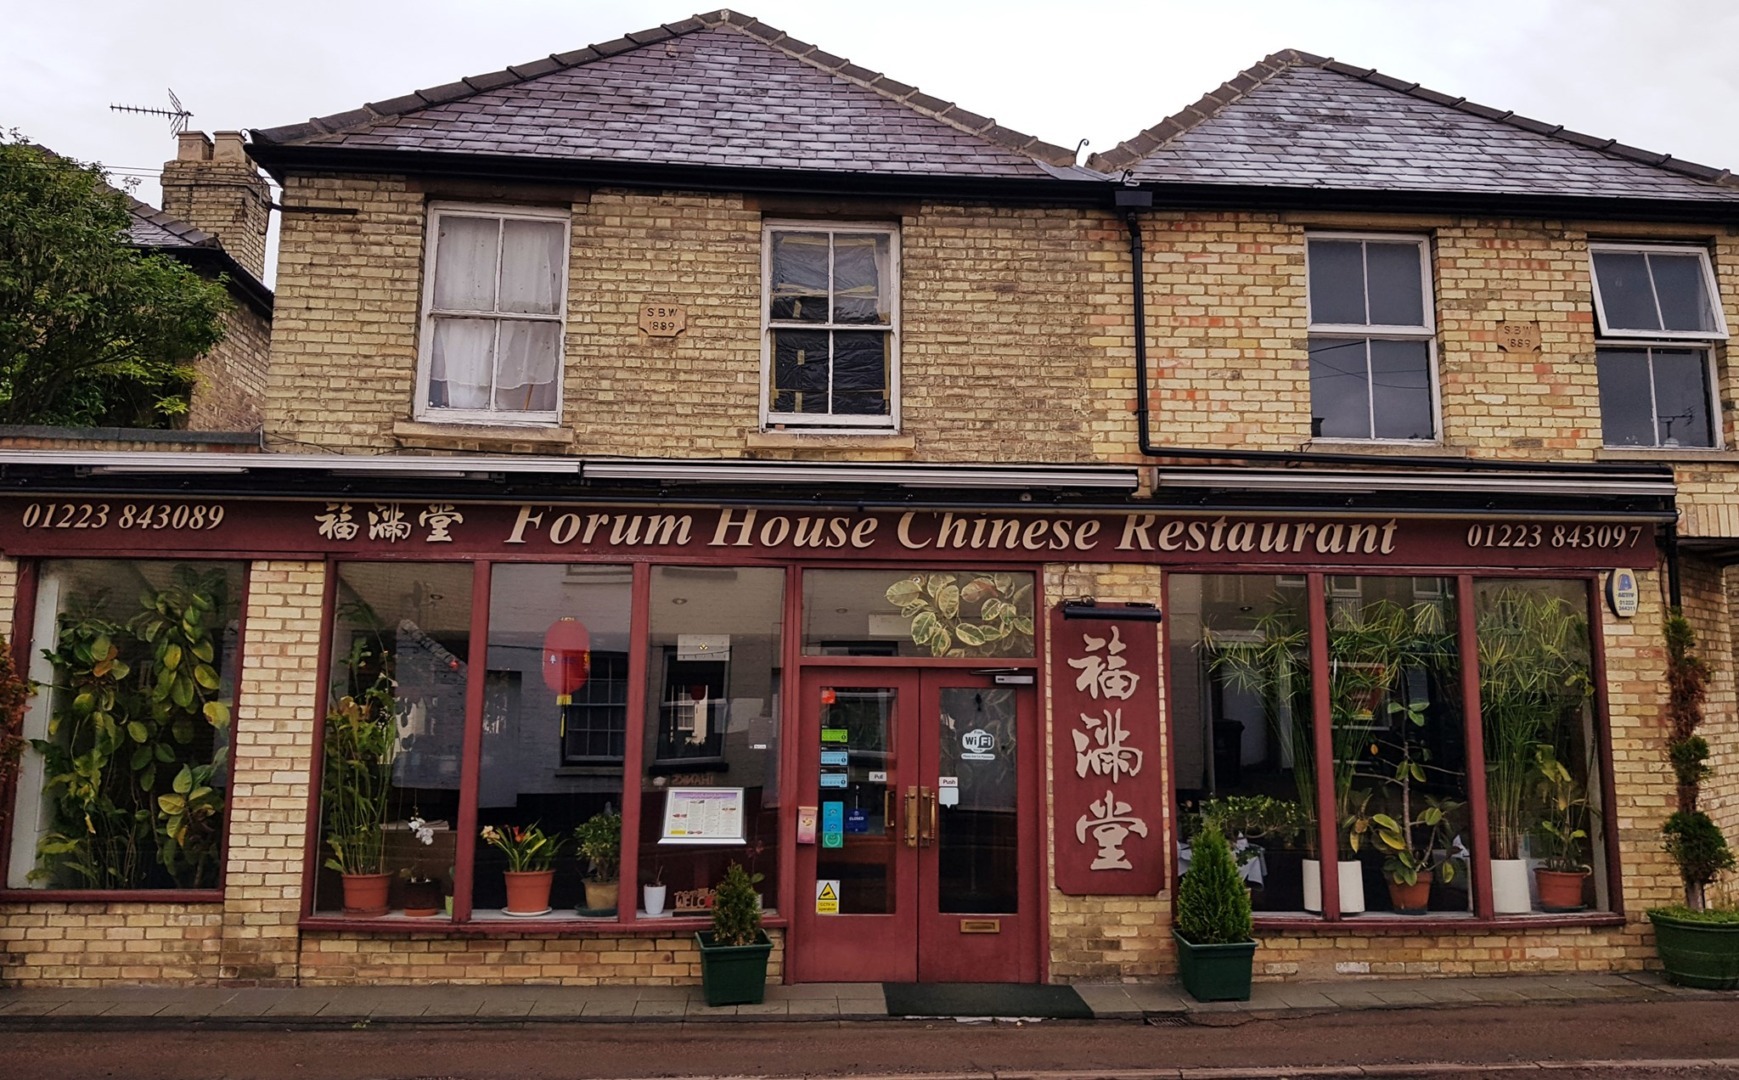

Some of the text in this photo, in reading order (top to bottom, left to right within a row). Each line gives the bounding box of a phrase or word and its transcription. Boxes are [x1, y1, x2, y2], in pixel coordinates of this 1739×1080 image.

[649, 321, 675, 331] 1889
[22, 503, 225, 530] 01223 843089
[503, 505, 1397, 555] Forum House Chinese Restaurant
[1467, 524, 1642, 548] 01223 843097
